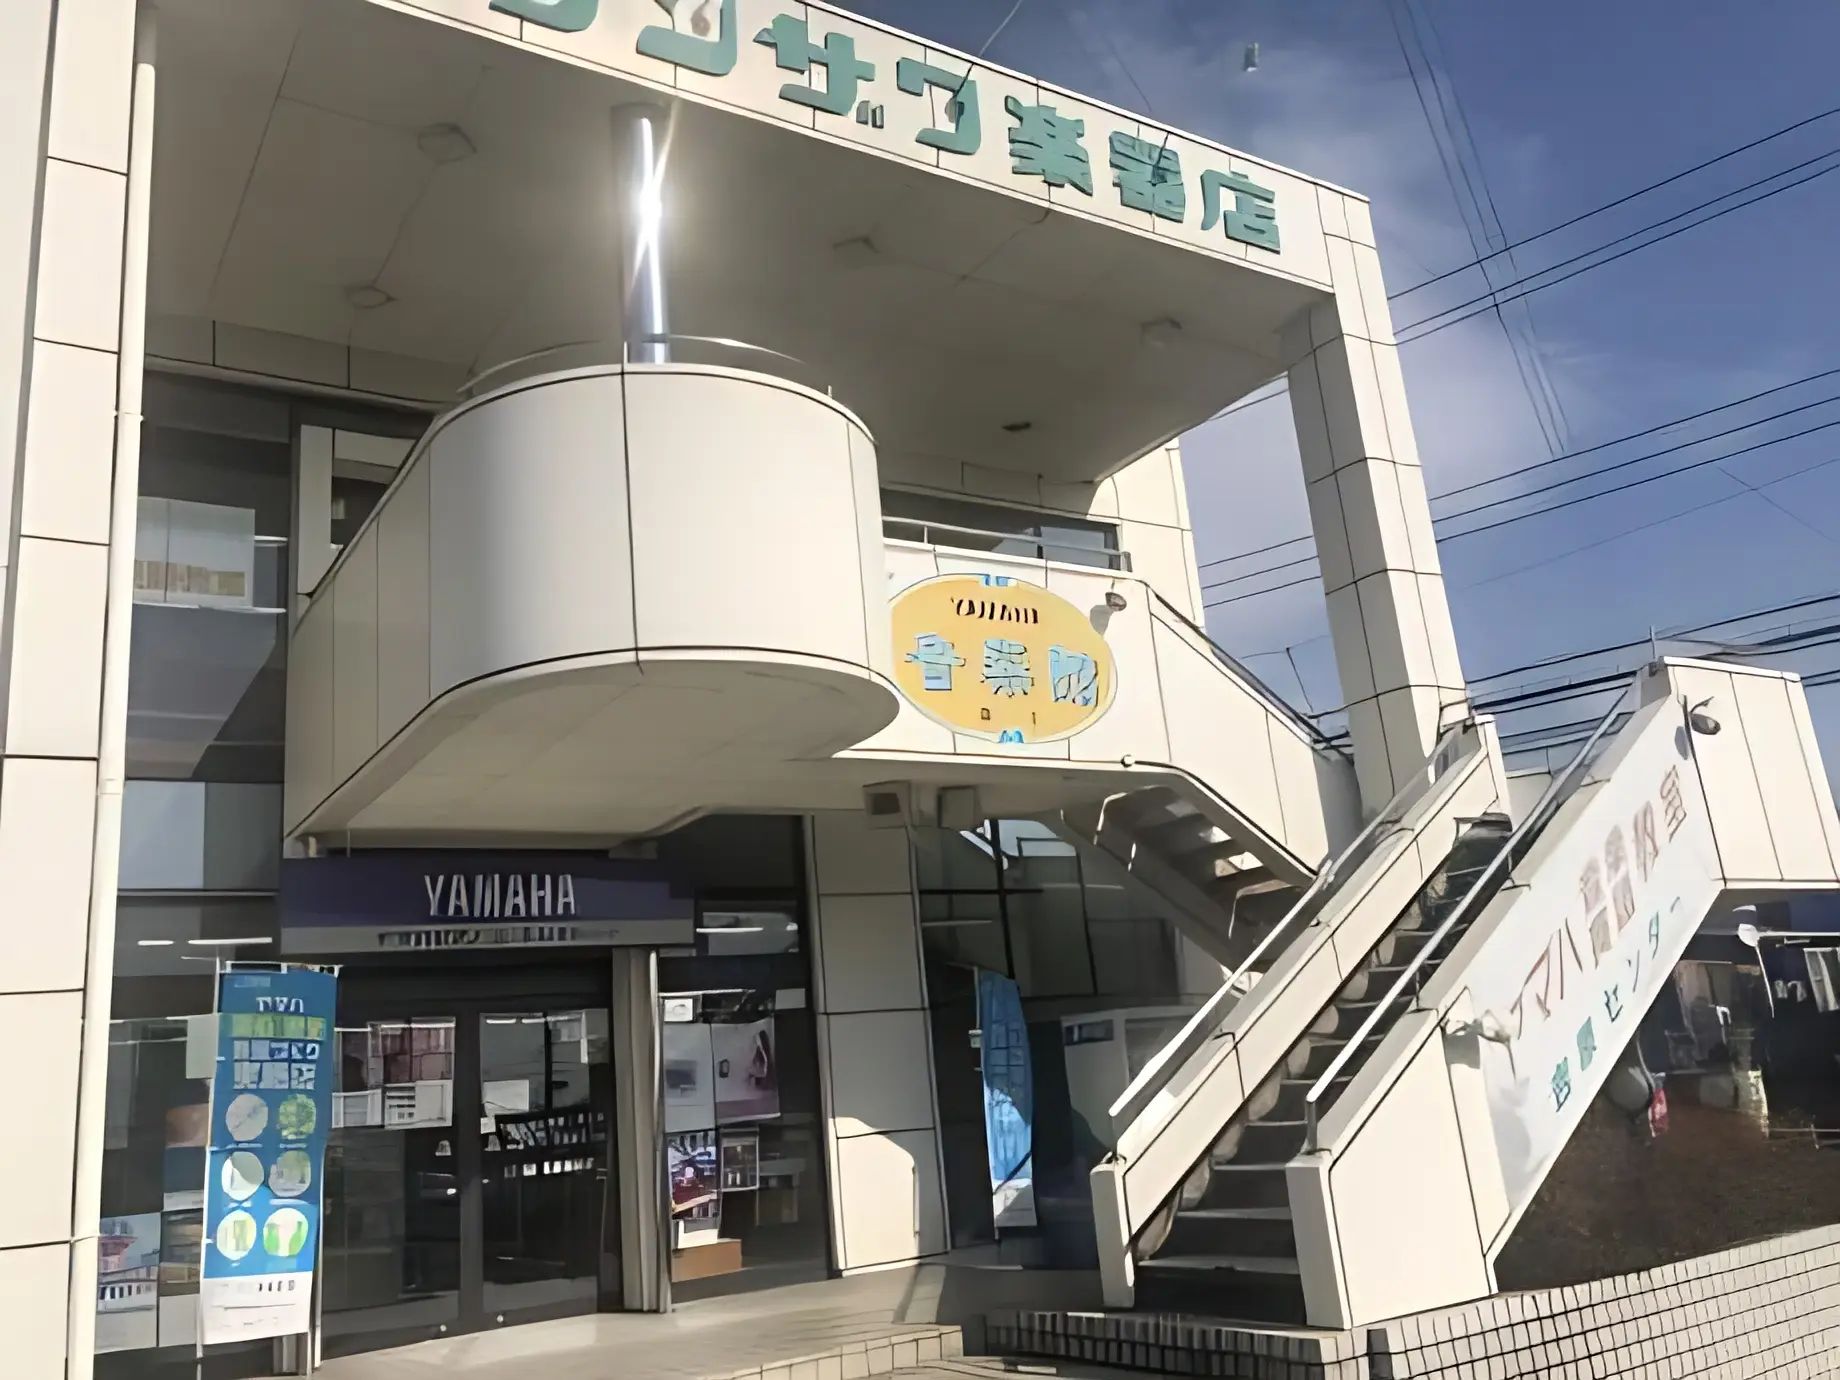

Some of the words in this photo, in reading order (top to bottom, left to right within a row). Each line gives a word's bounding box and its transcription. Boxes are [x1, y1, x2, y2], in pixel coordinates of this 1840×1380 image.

[489, 0, 1280, 254] ンザワ楽器店
[424, 873, 576, 918] YAMAHA
